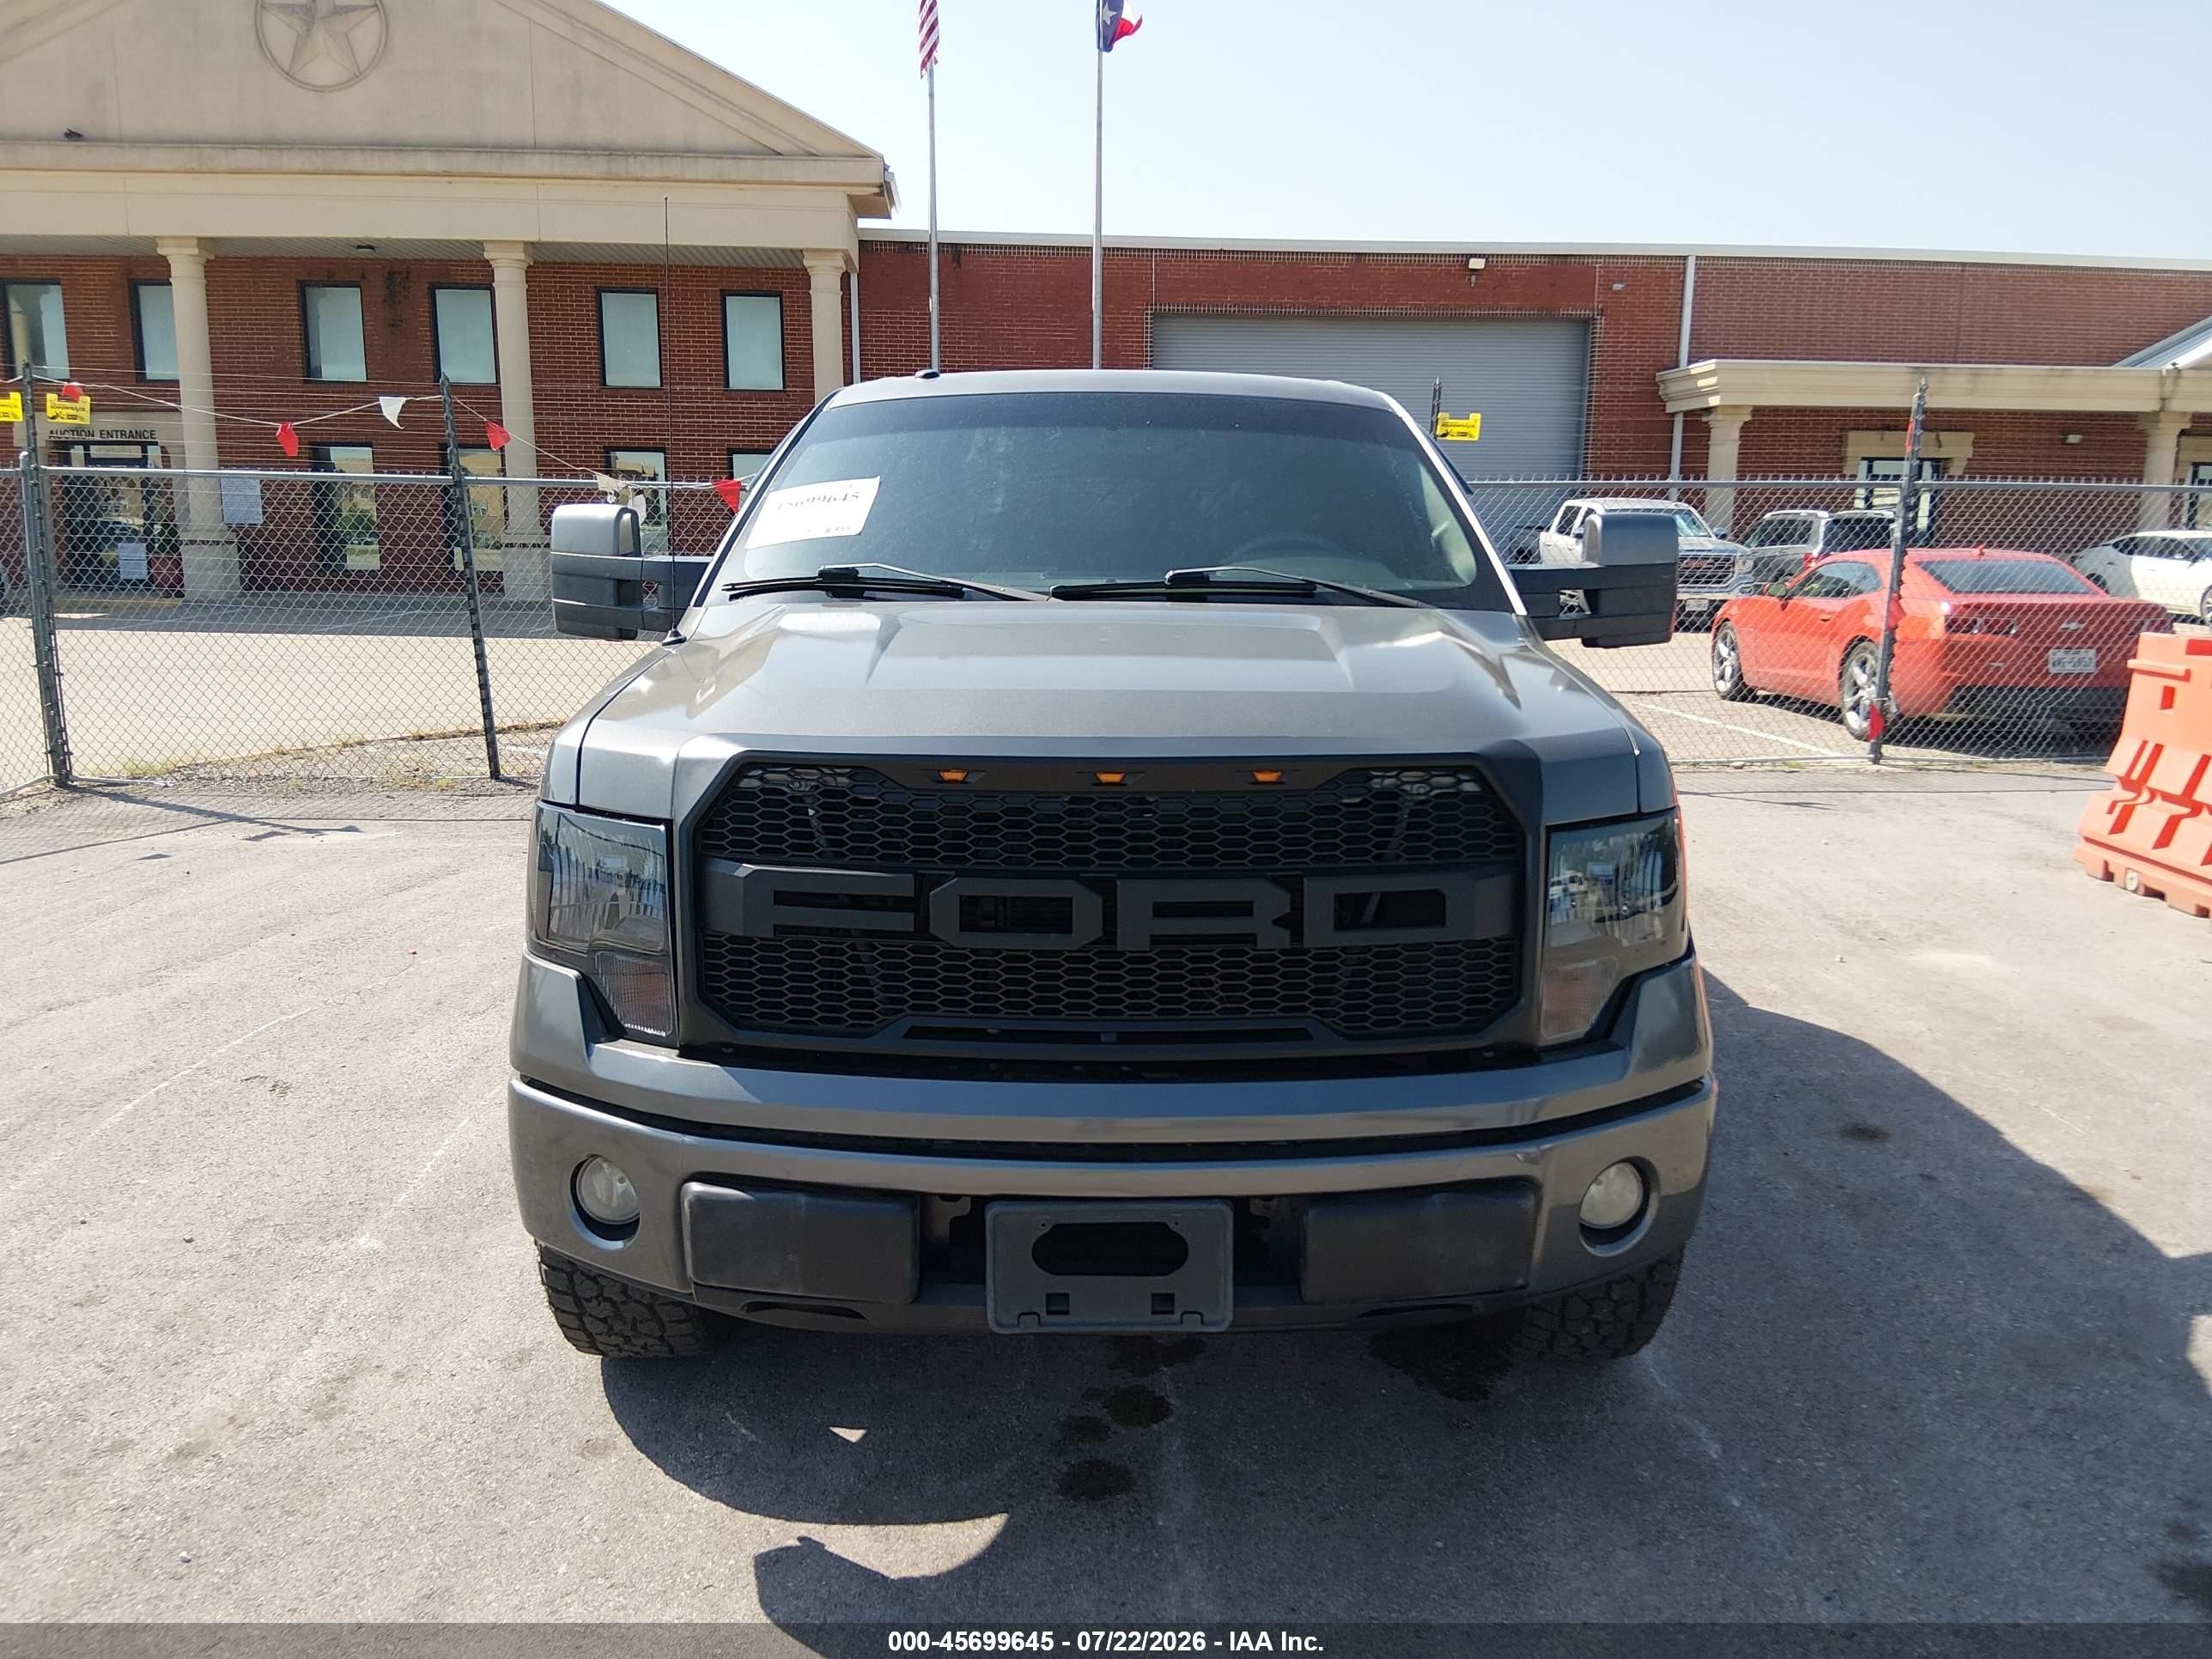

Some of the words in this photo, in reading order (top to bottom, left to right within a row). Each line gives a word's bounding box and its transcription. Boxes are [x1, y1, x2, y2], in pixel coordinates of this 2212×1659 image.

[49, 429, 94, 440] AUCTION
[100, 429, 157, 440] ENTRANCE
[743, 865, 1479, 951] FORD
